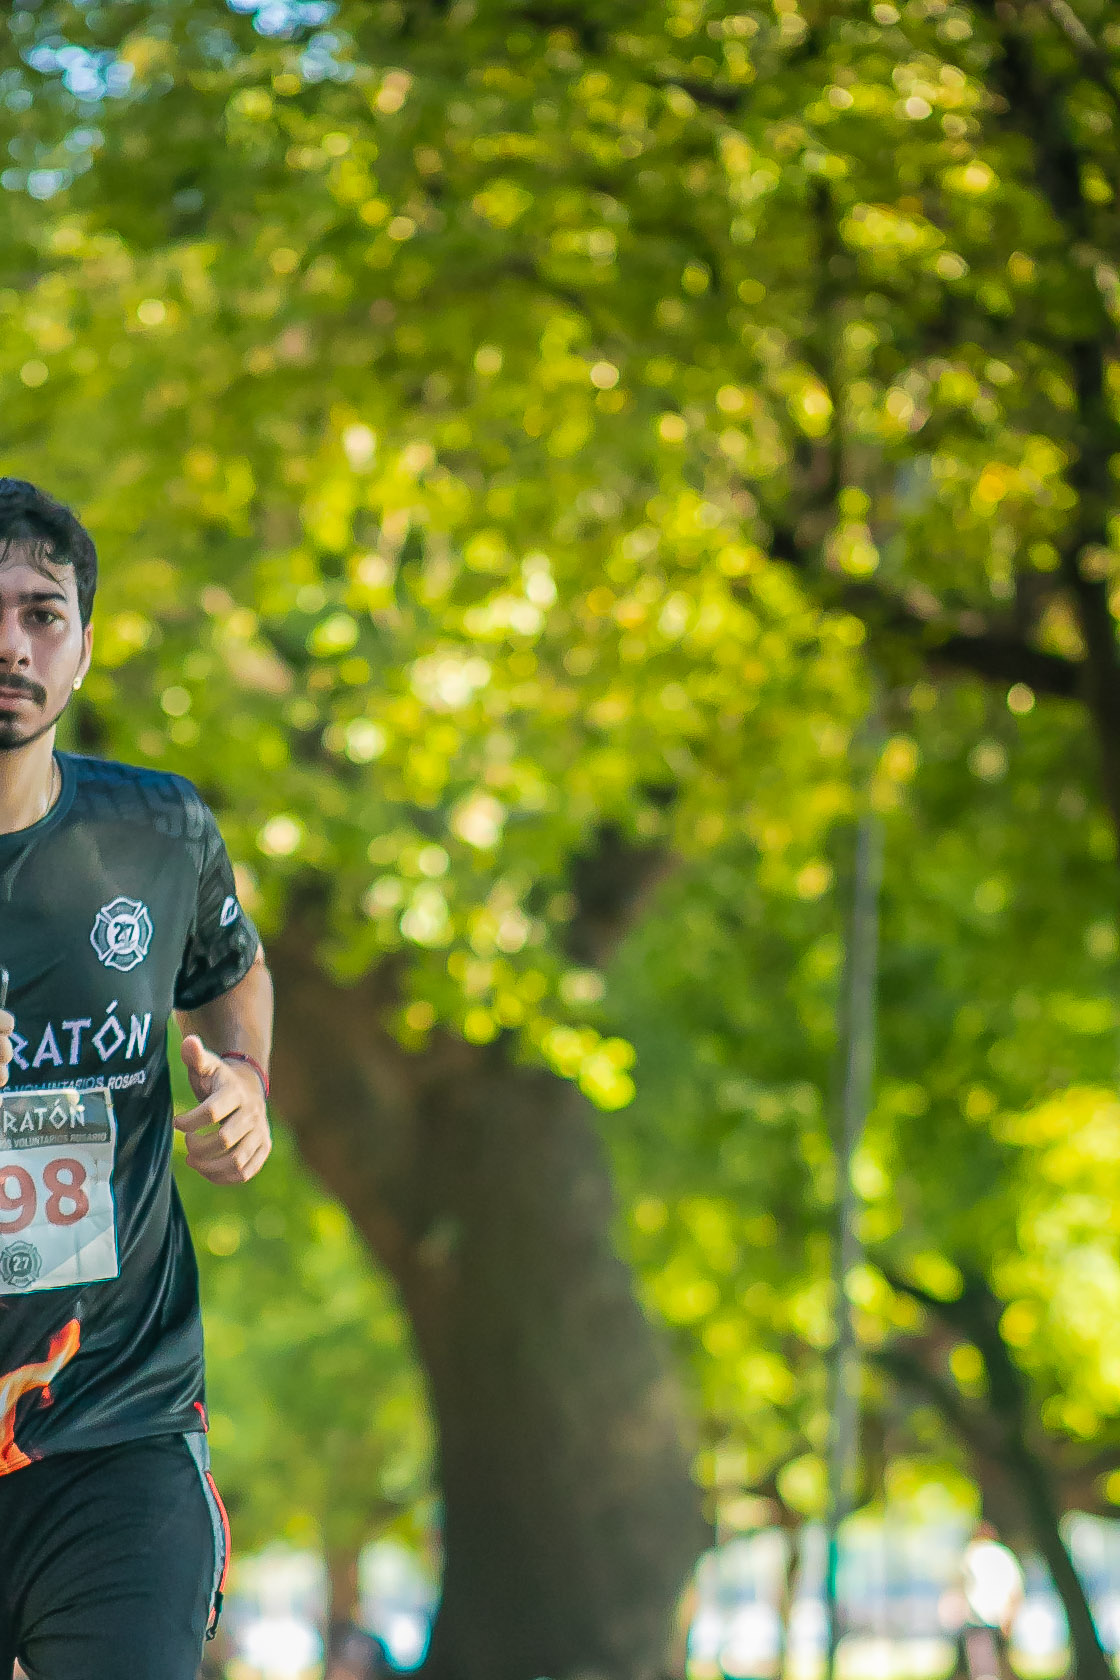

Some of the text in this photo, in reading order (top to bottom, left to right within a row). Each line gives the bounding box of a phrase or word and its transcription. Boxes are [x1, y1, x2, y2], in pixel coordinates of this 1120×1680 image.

[113, 921, 136, 945] 27
[7, 999, 153, 1071] RATÓN
[12, 1255, 30, 1272] 27
